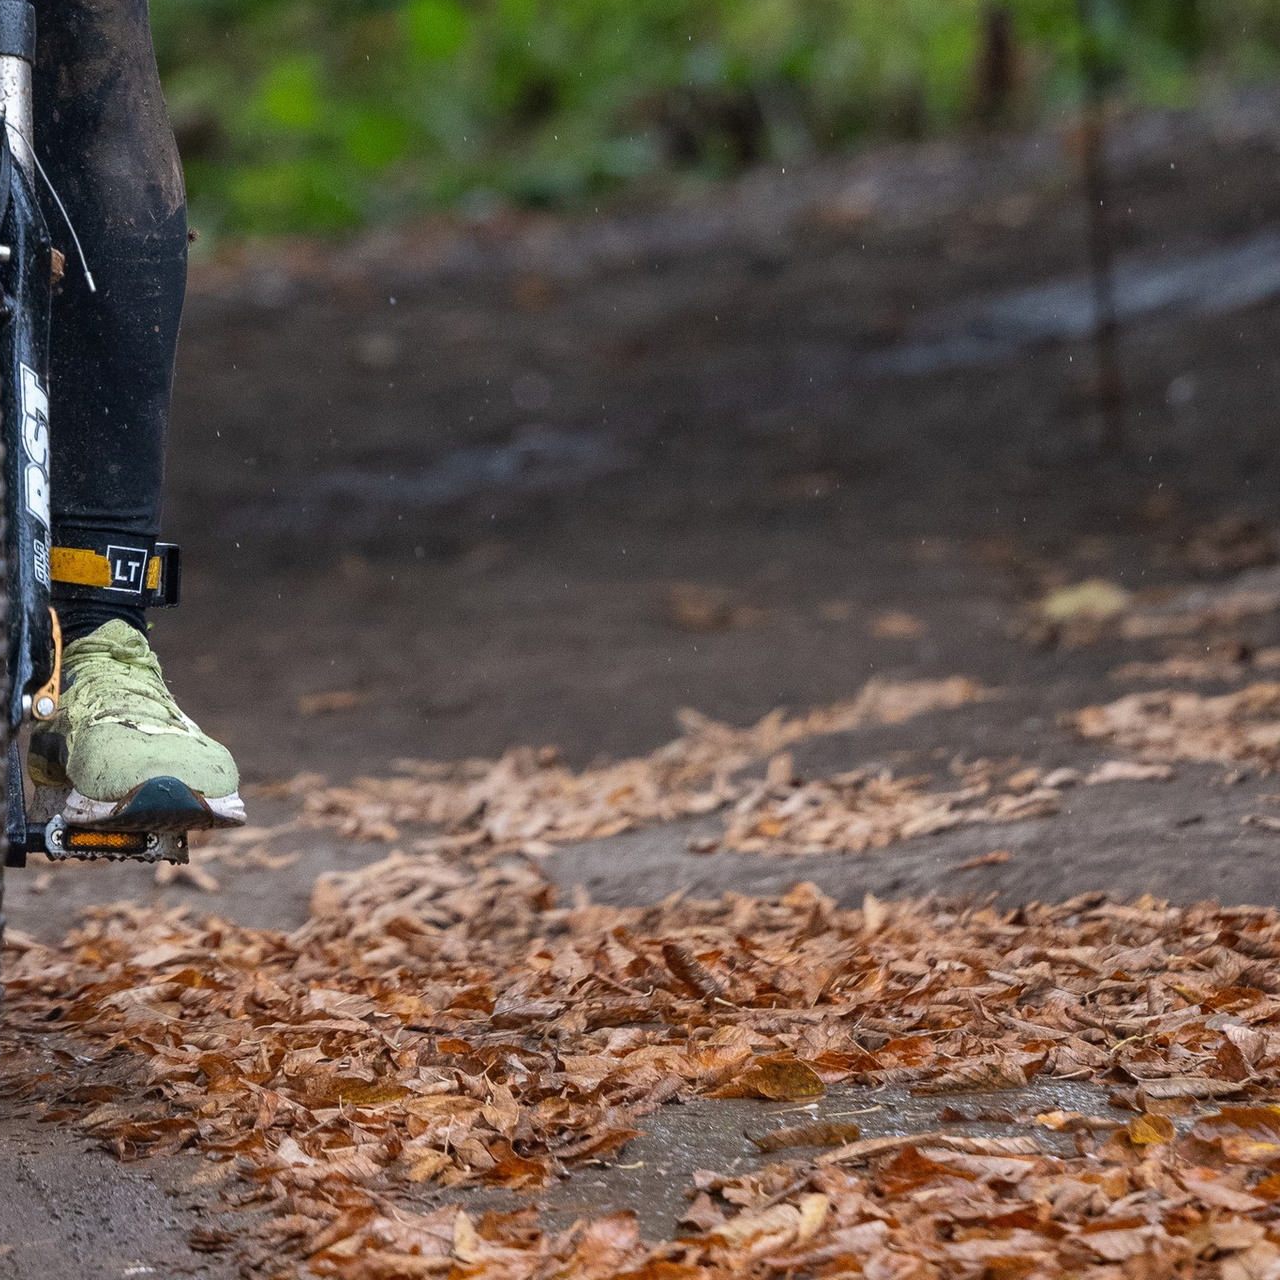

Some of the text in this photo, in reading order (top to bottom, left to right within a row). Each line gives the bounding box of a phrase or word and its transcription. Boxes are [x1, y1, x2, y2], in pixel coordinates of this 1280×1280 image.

[20, 362, 50, 531] RST
[34, 539, 45, 586] GILA
[114, 559, 141, 583] LT
